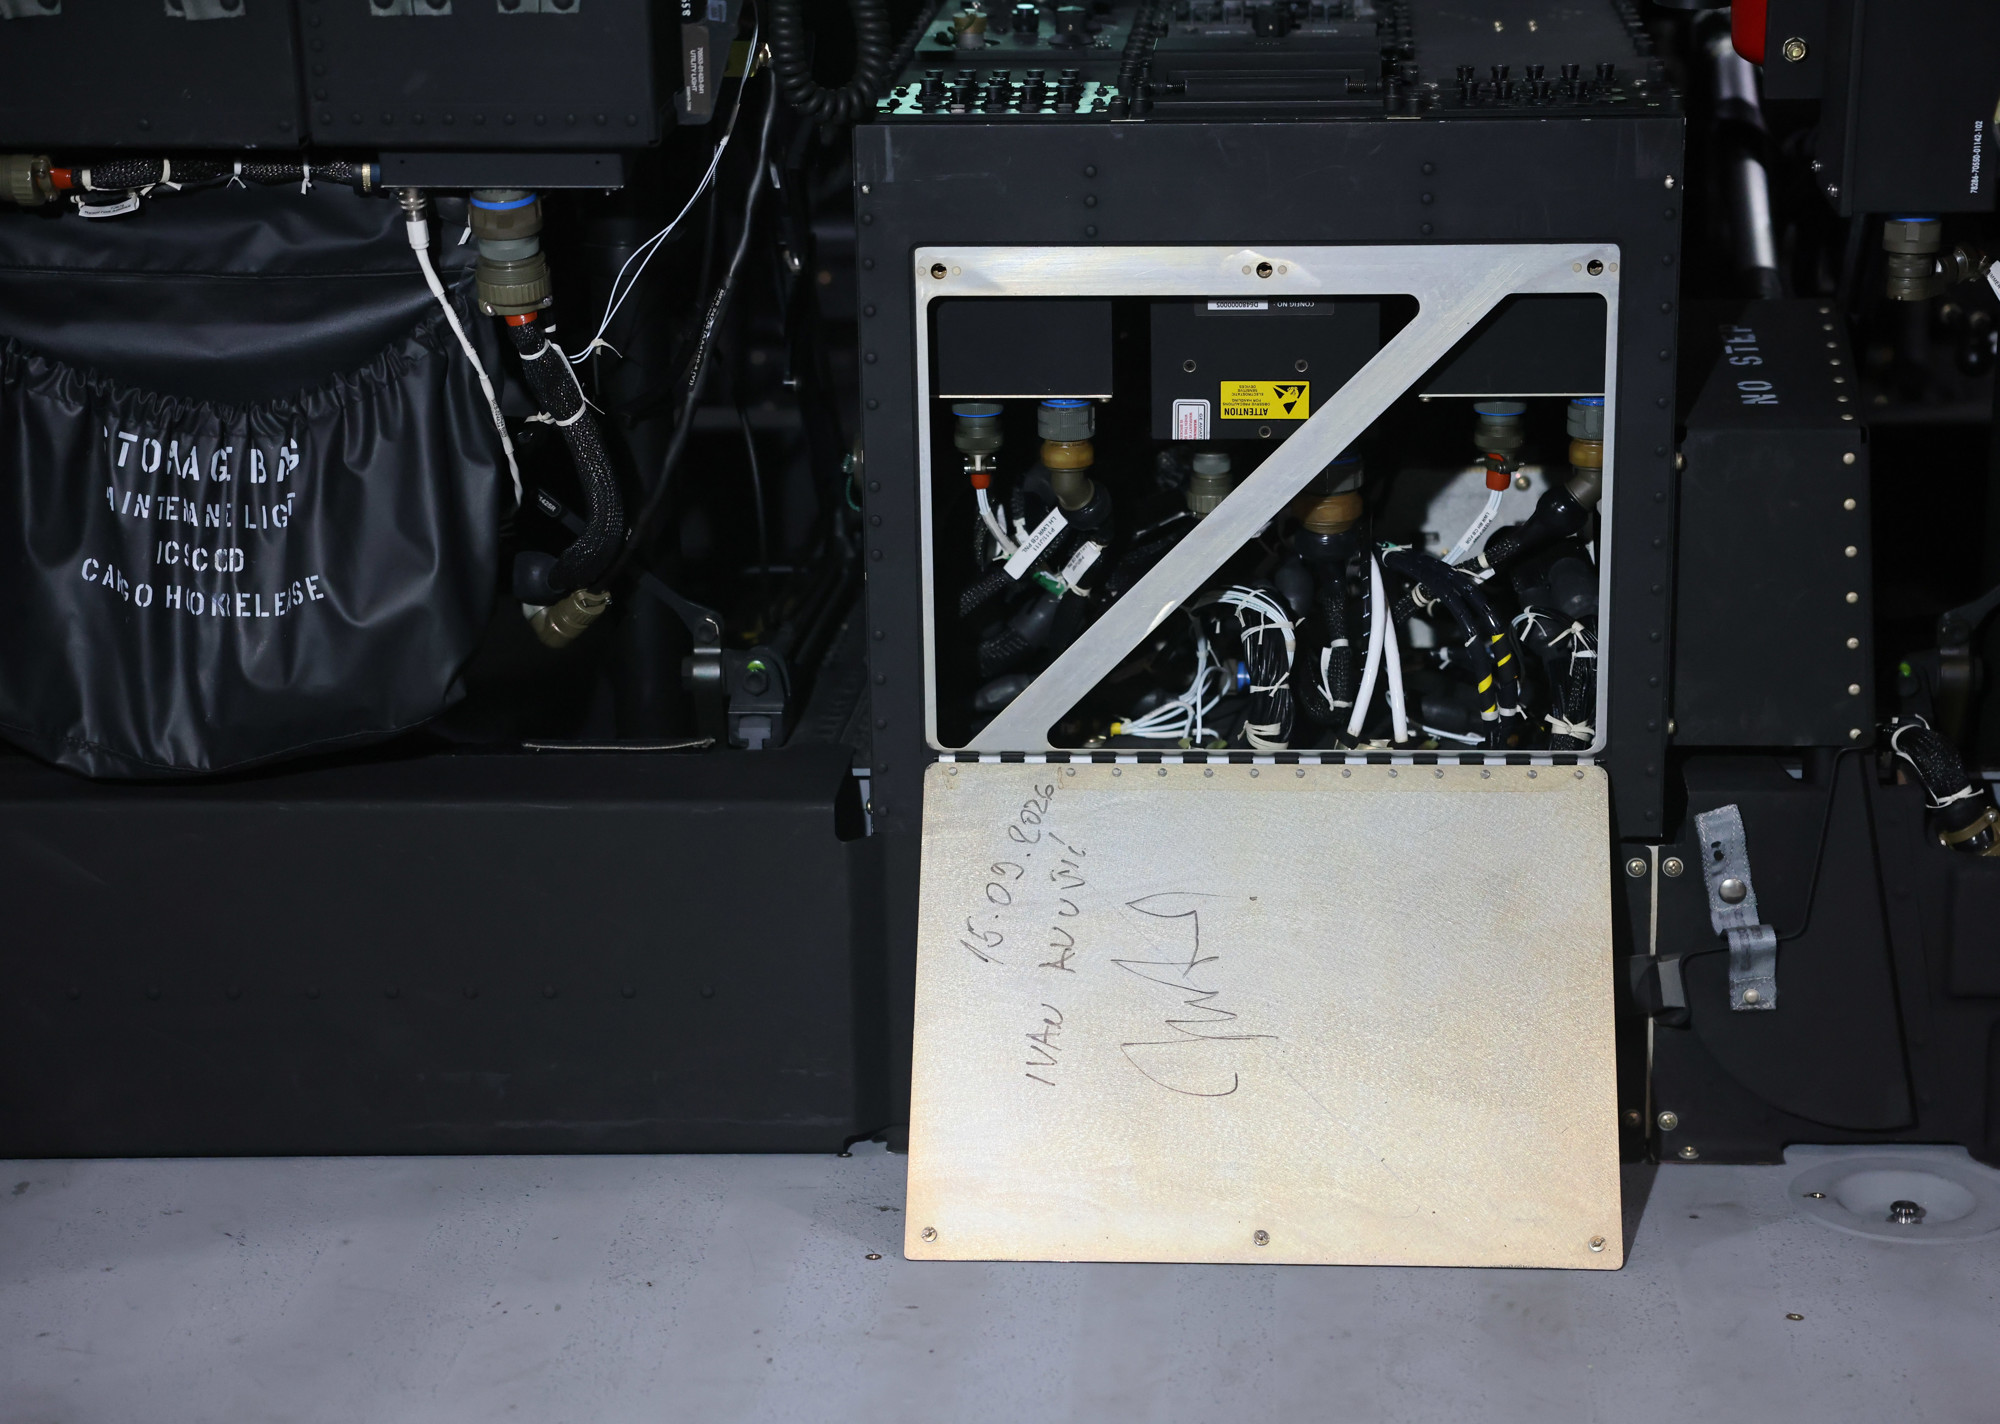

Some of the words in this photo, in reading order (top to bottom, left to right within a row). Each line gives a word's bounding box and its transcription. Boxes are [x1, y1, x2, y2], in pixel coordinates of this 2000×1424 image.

[1736, 380, 1779, 405] NO
[1224, 407, 1269, 416] ATTENTION
[1047, 516, 1057, 525] LH
[1037, 523, 1050, 537] LWR
[1030, 534, 1040, 545] CB
[1021, 542, 1033, 555] PNL
[1025, 1002, 1064, 1087] IVAN
